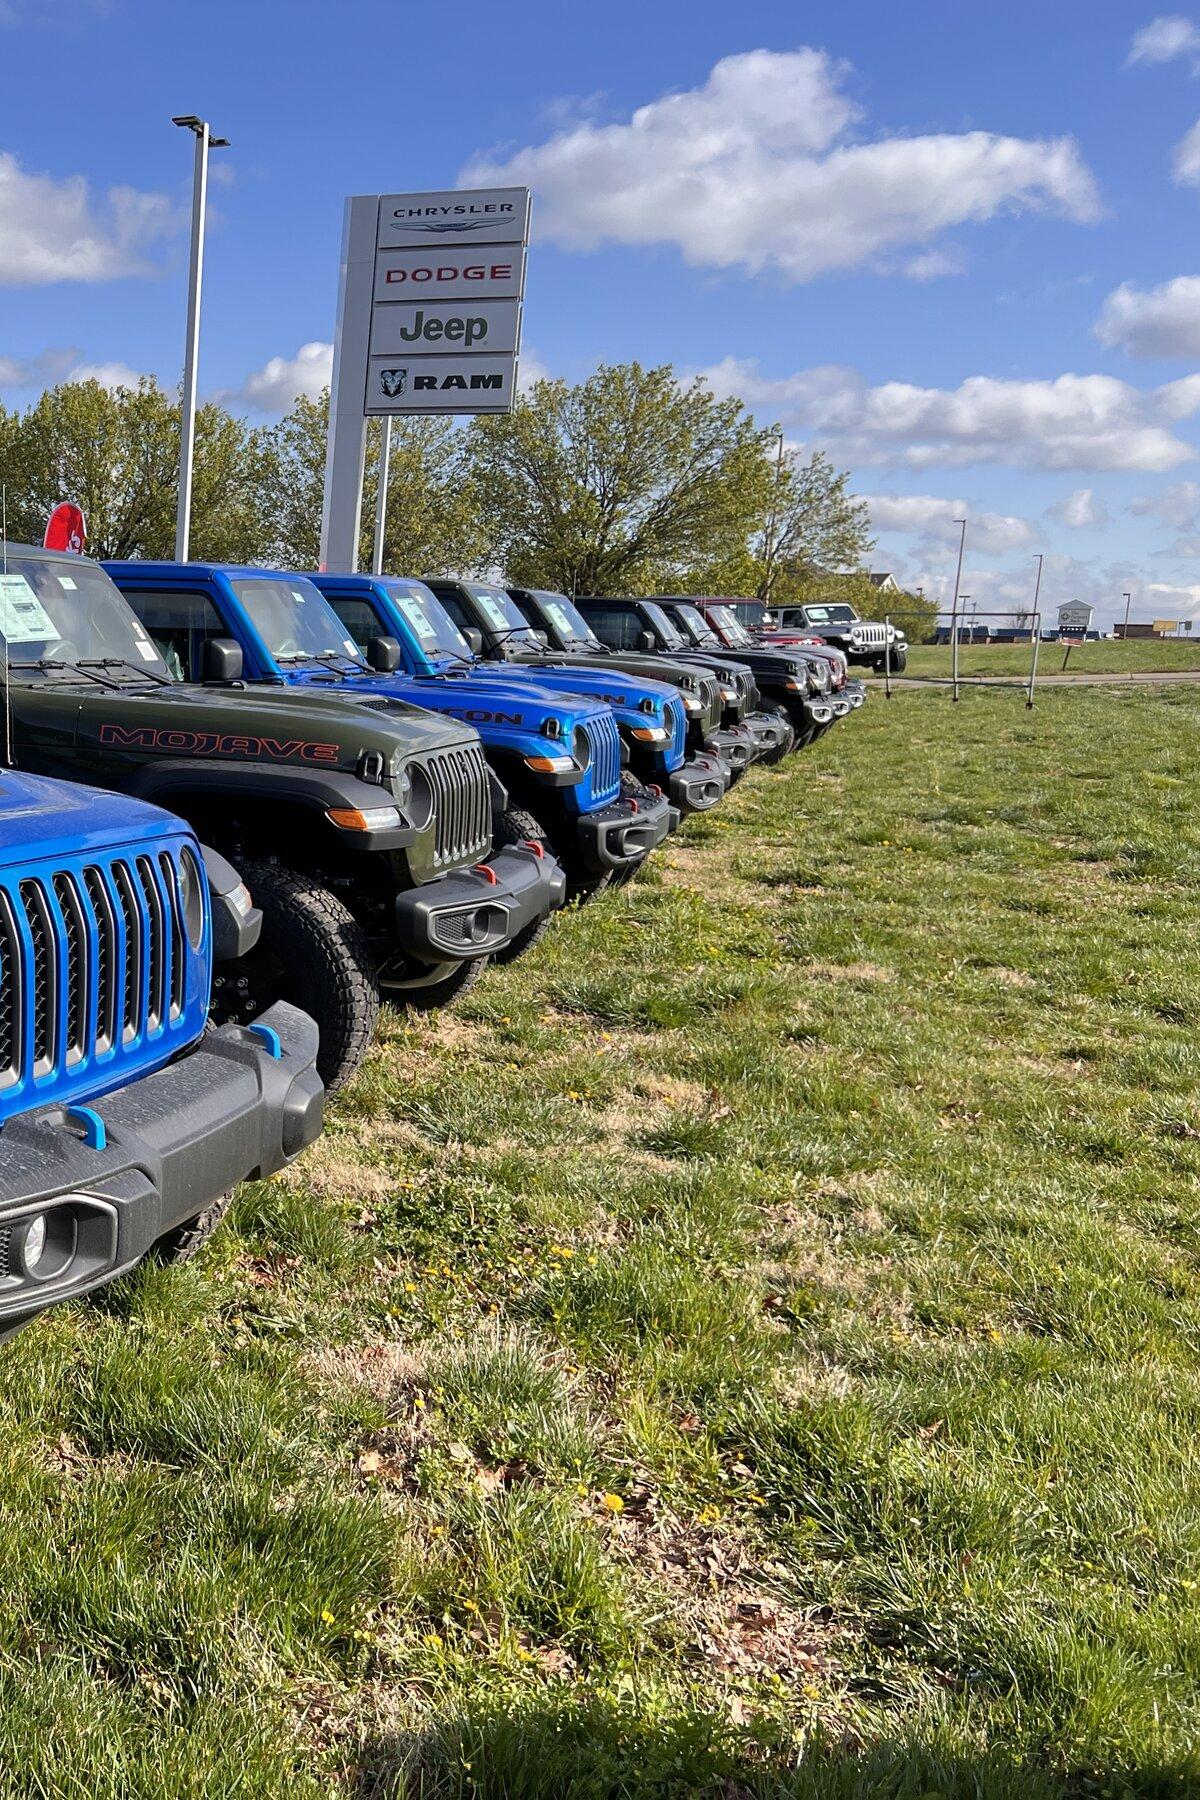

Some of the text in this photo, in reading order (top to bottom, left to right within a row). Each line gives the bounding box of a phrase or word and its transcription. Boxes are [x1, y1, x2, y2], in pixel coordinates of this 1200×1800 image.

[393, 203, 514, 218] CHRYSLER
[385, 264, 512, 284] DODGE
[400, 311, 488, 346] Jeep
[413, 374, 503, 390] RAM
[100, 724, 340, 763] MOJAVE
